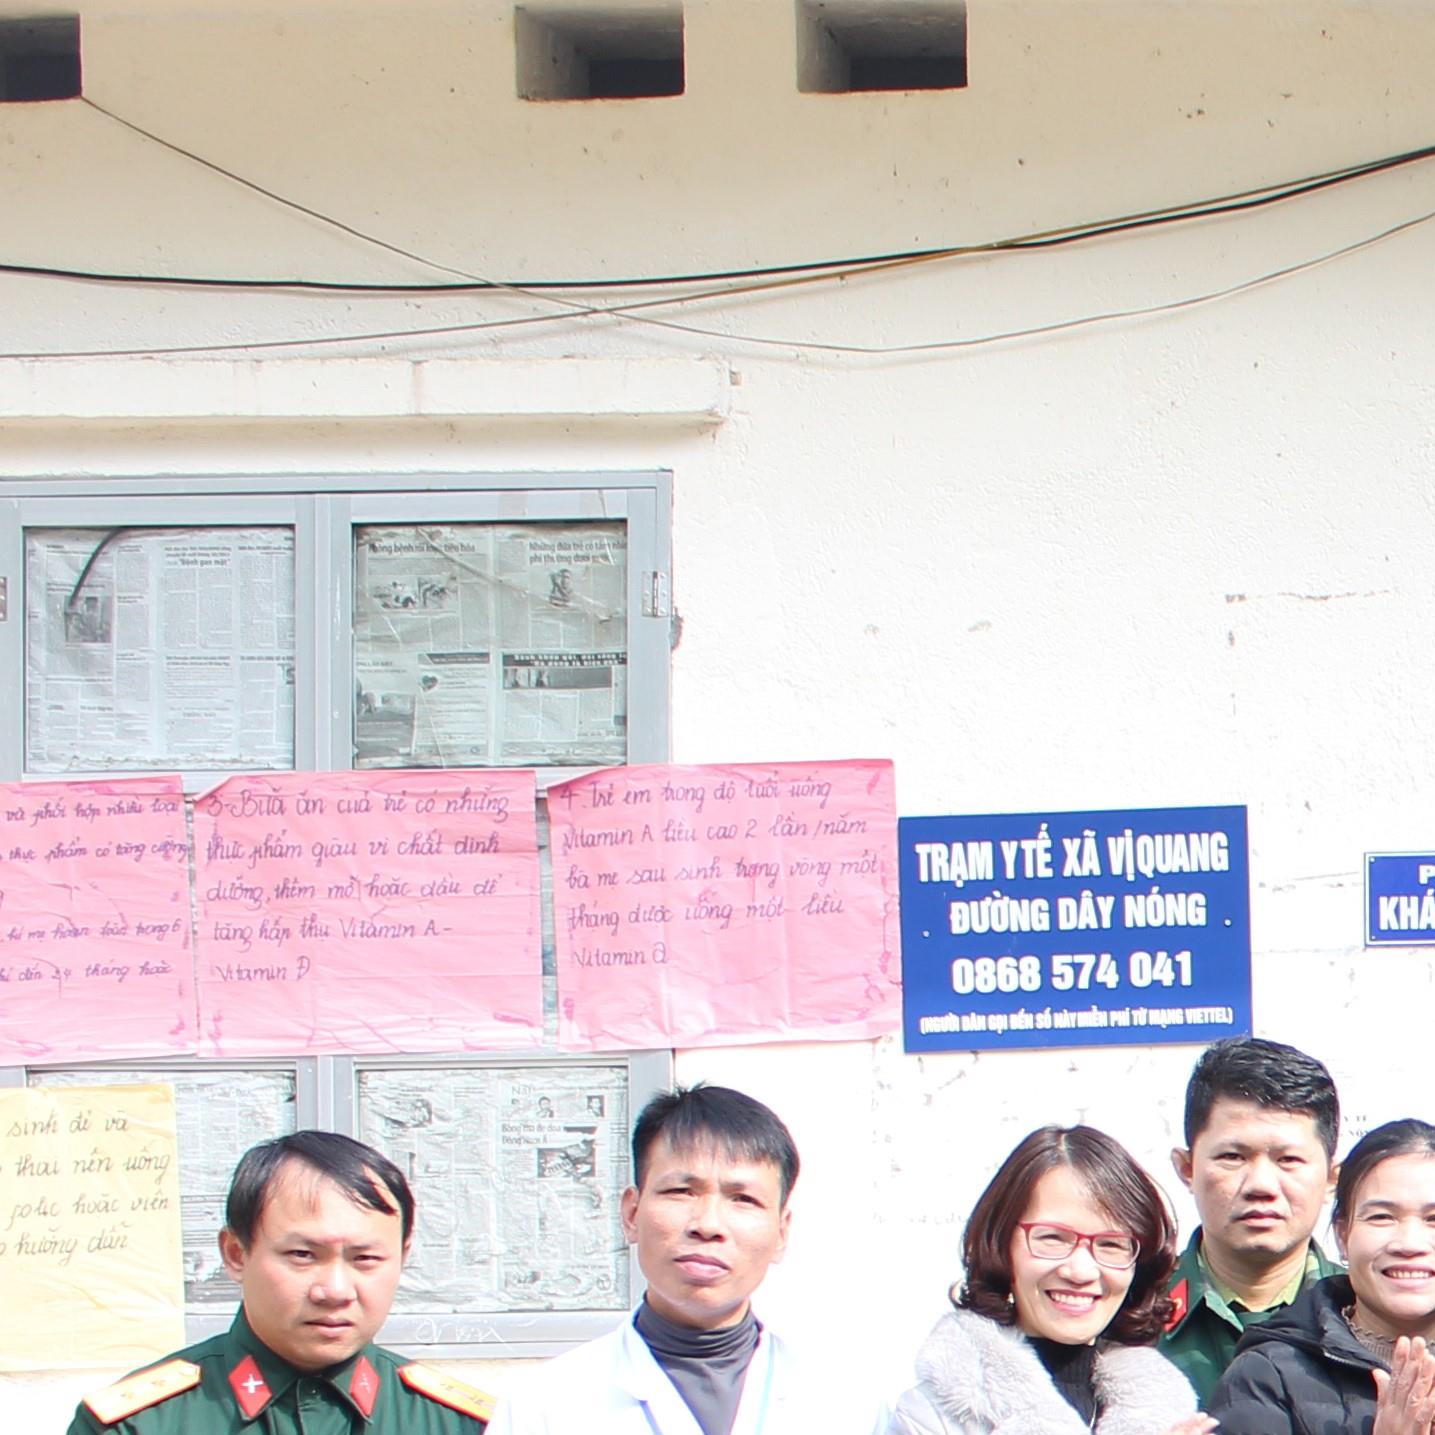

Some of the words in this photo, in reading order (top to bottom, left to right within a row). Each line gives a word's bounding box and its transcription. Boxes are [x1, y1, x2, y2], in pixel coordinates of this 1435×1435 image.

[949, 890, 1050, 935] ĐƯỜNG
[1057, 889, 1115, 931] DÂY
[1124, 885, 1207, 929] NÓNG
[951, 955, 1042, 994] 0868
[1051, 953, 1120, 991] 574
[1129, 950, 1193, 988] 041
